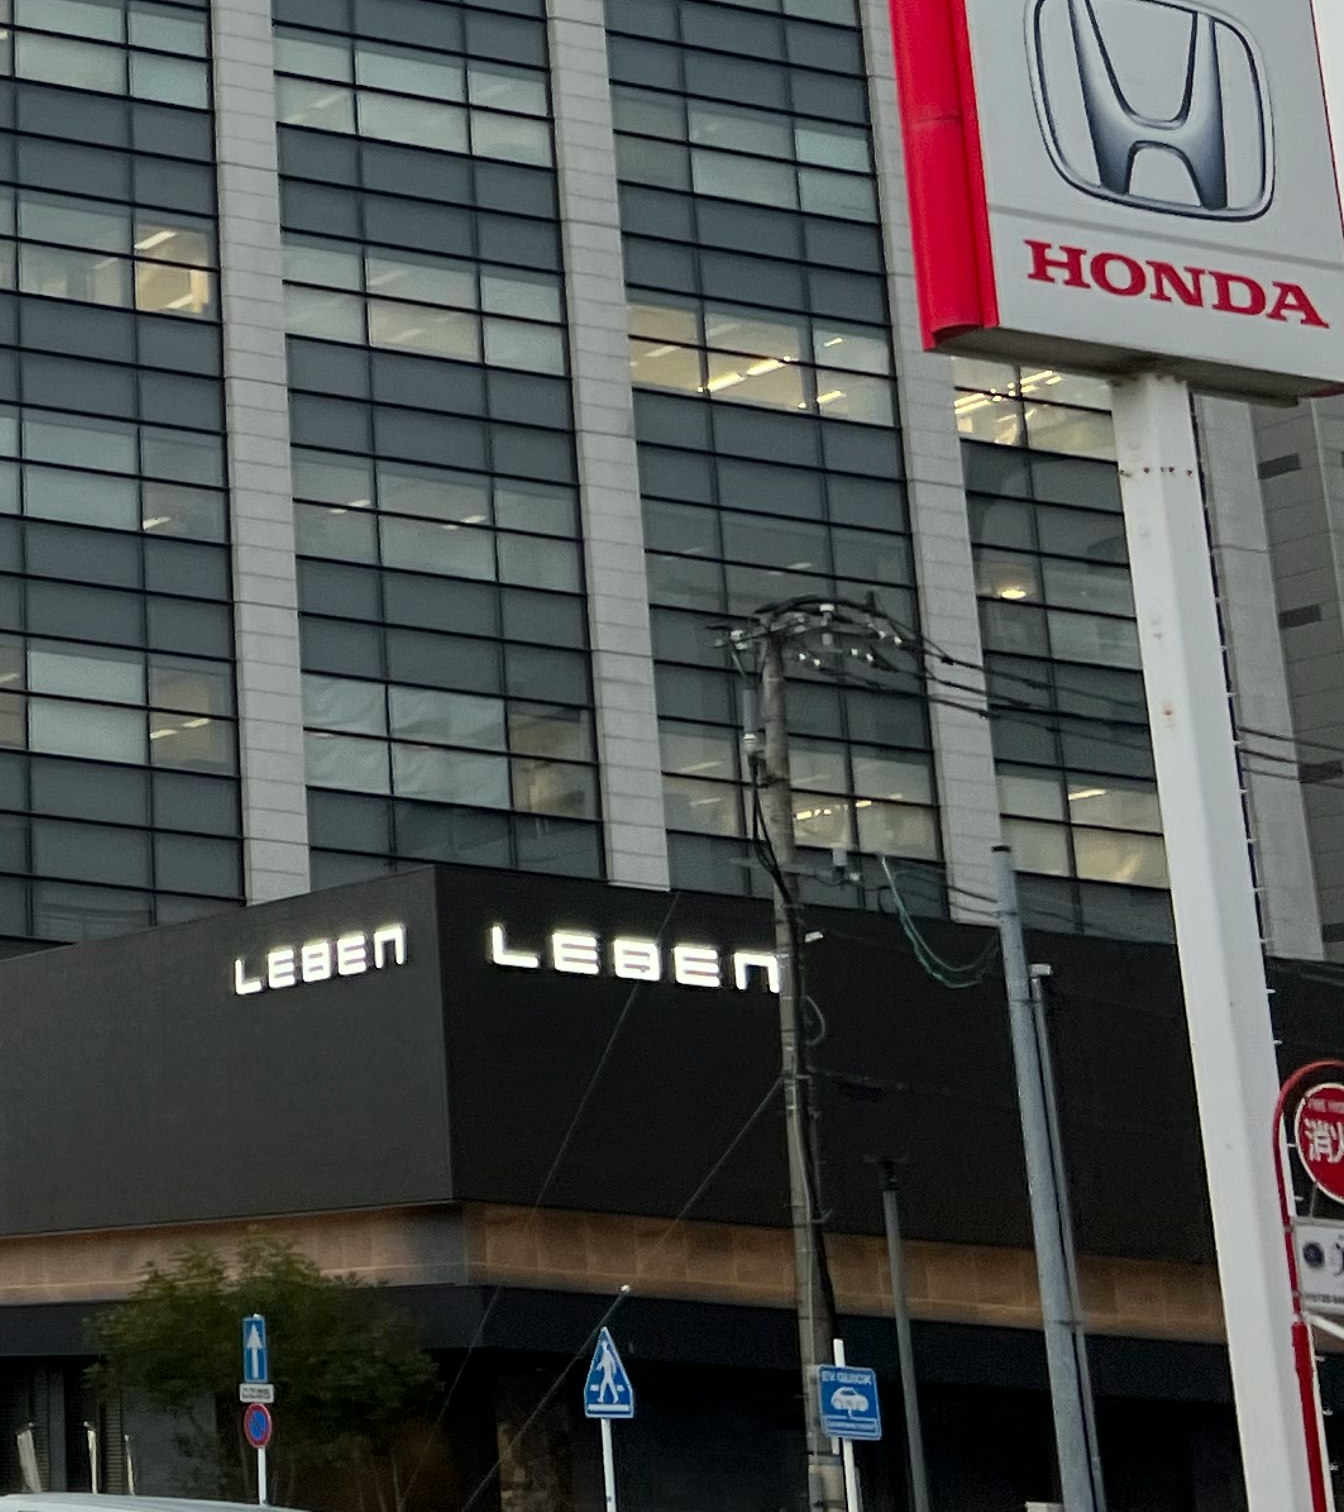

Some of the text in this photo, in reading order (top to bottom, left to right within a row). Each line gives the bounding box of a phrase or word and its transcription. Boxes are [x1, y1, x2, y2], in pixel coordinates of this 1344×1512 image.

[1024, 240, 1330, 329] HONDA
[234, 923, 405, 995] LEBEN
[491, 924, 780, 994] LEBEN
